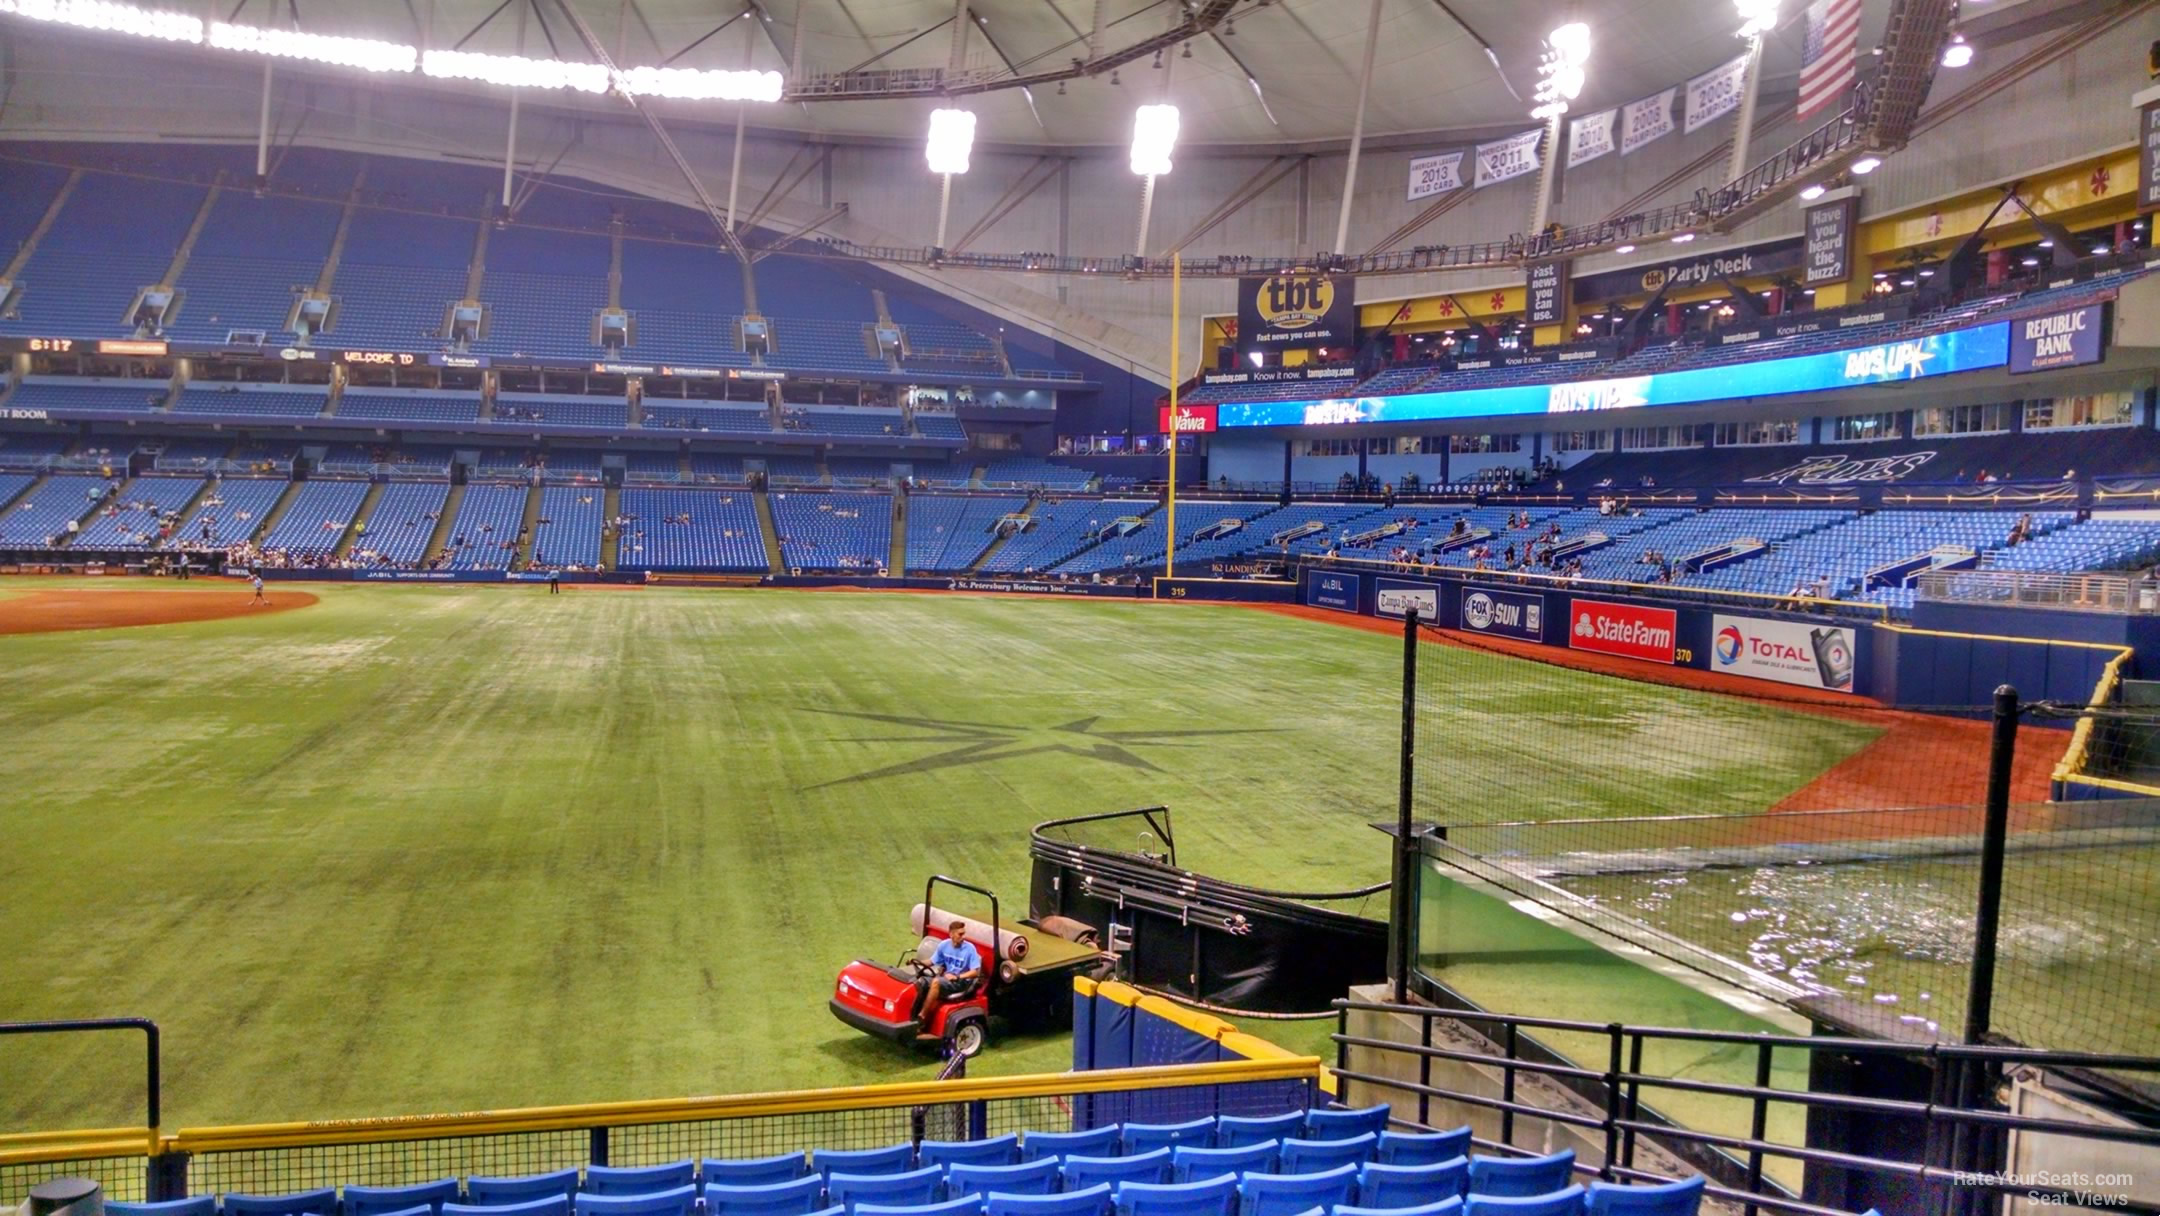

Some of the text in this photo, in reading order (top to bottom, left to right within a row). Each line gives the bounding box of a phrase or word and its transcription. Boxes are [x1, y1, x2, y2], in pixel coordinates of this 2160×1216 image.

[1578, 127, 1603, 148] 2010
[1478, 144, 1508, 157] AMERICAN
[1411, 161, 1437, 171] AMERICAN
[1491, 149, 1522, 169] 2011
[1422, 166, 1448, 184] 2013
[1482, 162, 1530, 181] WILD CARD
[1414, 180, 1453, 194] WILD CARD
[1812, 209, 1841, 226] Have
[1816, 224, 1837, 241] you
[1809, 233, 1842, 254] heard
[1815, 251, 1835, 266] the
[1534, 263, 1553, 277] Fast
[1668, 261, 1709, 283] Party
[1808, 262, 1841, 281] buzz?
[1532, 277, 1557, 289] news
[1267, 276, 1323, 313] tbt
[1535, 288, 1553, 301] you
[1535, 299, 1552, 309] can
[1534, 309, 1553, 321] use.
[1777, 327, 1796, 335] Know
[1840, 313, 1884, 327] tampabay.com
[2026, 311, 2086, 339] REPUBLIC
[1257, 333, 1270, 341] Fast
[1290, 332, 1303, 341] you
[1304, 330, 1317, 338] can
[30, 339, 72, 351] 6:17
[2036, 333, 2073, 357] BANK
[345, 352, 394, 364] WELCOME
[1845, 343, 1913, 378] RAYS UP
[1205, 373, 1248, 384] tampabay.com
[1253, 372, 1275, 381] Know
[1282, 371, 1301, 380] now.
[1307, 368, 1354, 378] tampabay.com
[12, 410, 47, 419] ROOM
[1168, 415, 1205, 431] Wawa
[1225, 564, 1262, 574] LANDING
[970, 582, 1011, 592] Petersburg
[1013, 583, 1048, 592] Welcomes
[1171, 588, 1186, 596] 315
[1322, 579, 1343, 591] JABIL
[1380, 593, 1401, 611] Tampa
[1472, 600, 1487, 615] FOX
[1676, 649, 1692, 662] 370
[1749, 638, 1811, 662] TOTAL
